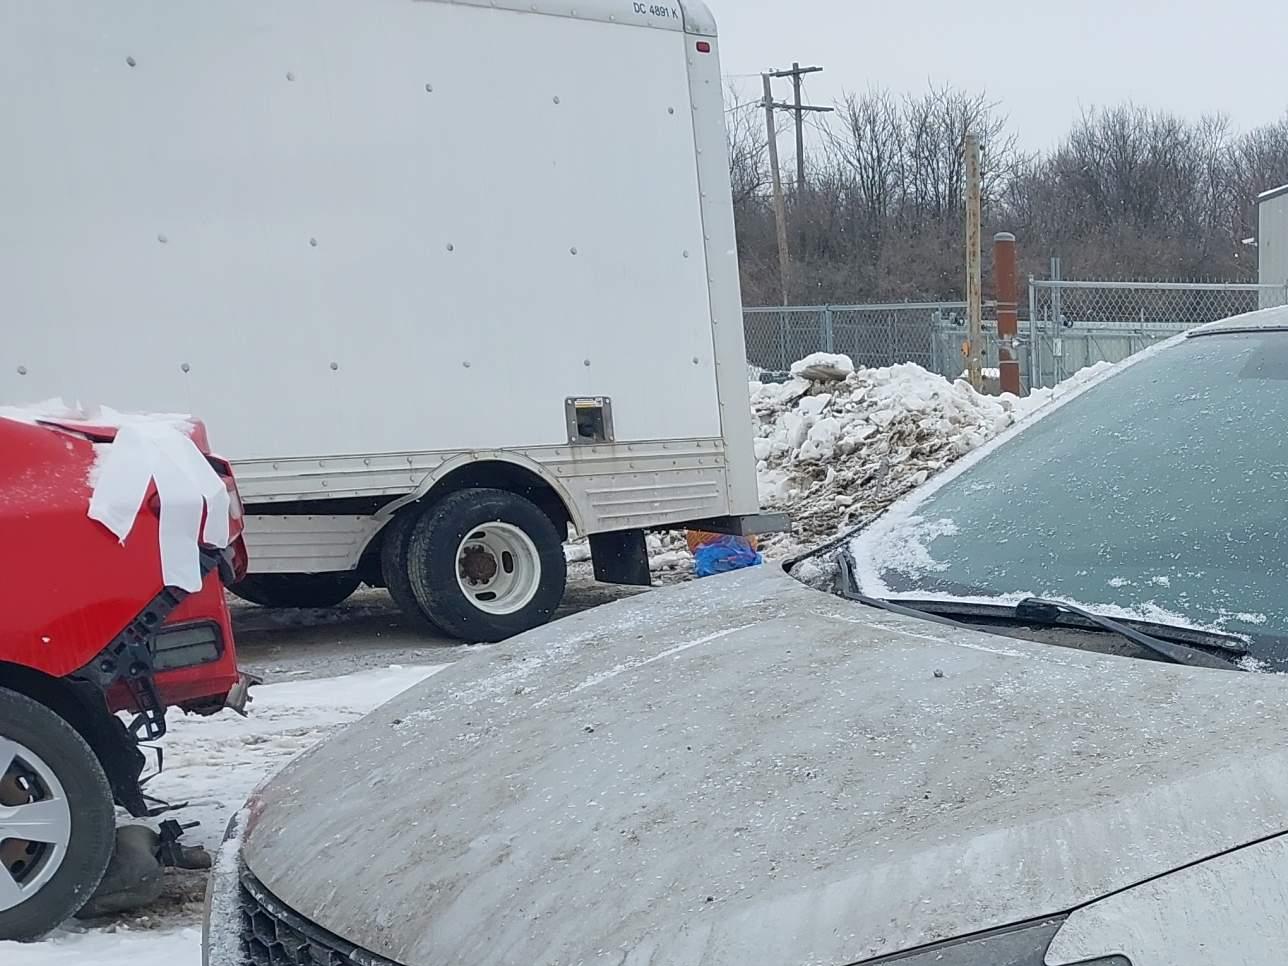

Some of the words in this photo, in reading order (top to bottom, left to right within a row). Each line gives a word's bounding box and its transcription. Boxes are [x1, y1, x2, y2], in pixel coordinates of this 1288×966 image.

[633, 2, 646, 14] DC
[649, 5, 669, 17] 4891
[671, 7, 679, 19] K
